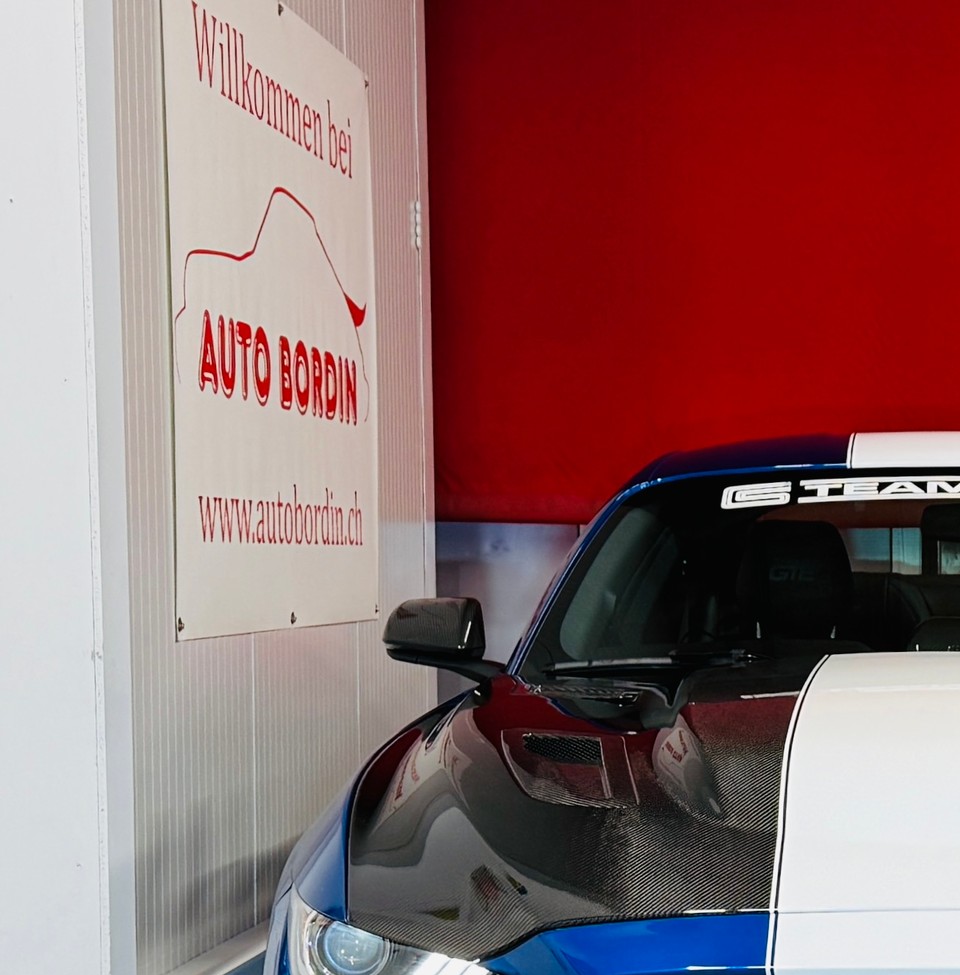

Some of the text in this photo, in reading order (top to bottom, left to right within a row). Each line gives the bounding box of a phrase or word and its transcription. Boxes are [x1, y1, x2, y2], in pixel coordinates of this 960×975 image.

[191, 0, 352, 179] Willkommen bei
[198, 309, 357, 426] AUTO BORDIN
[198, 484, 363, 546] www.autobordin.ch
